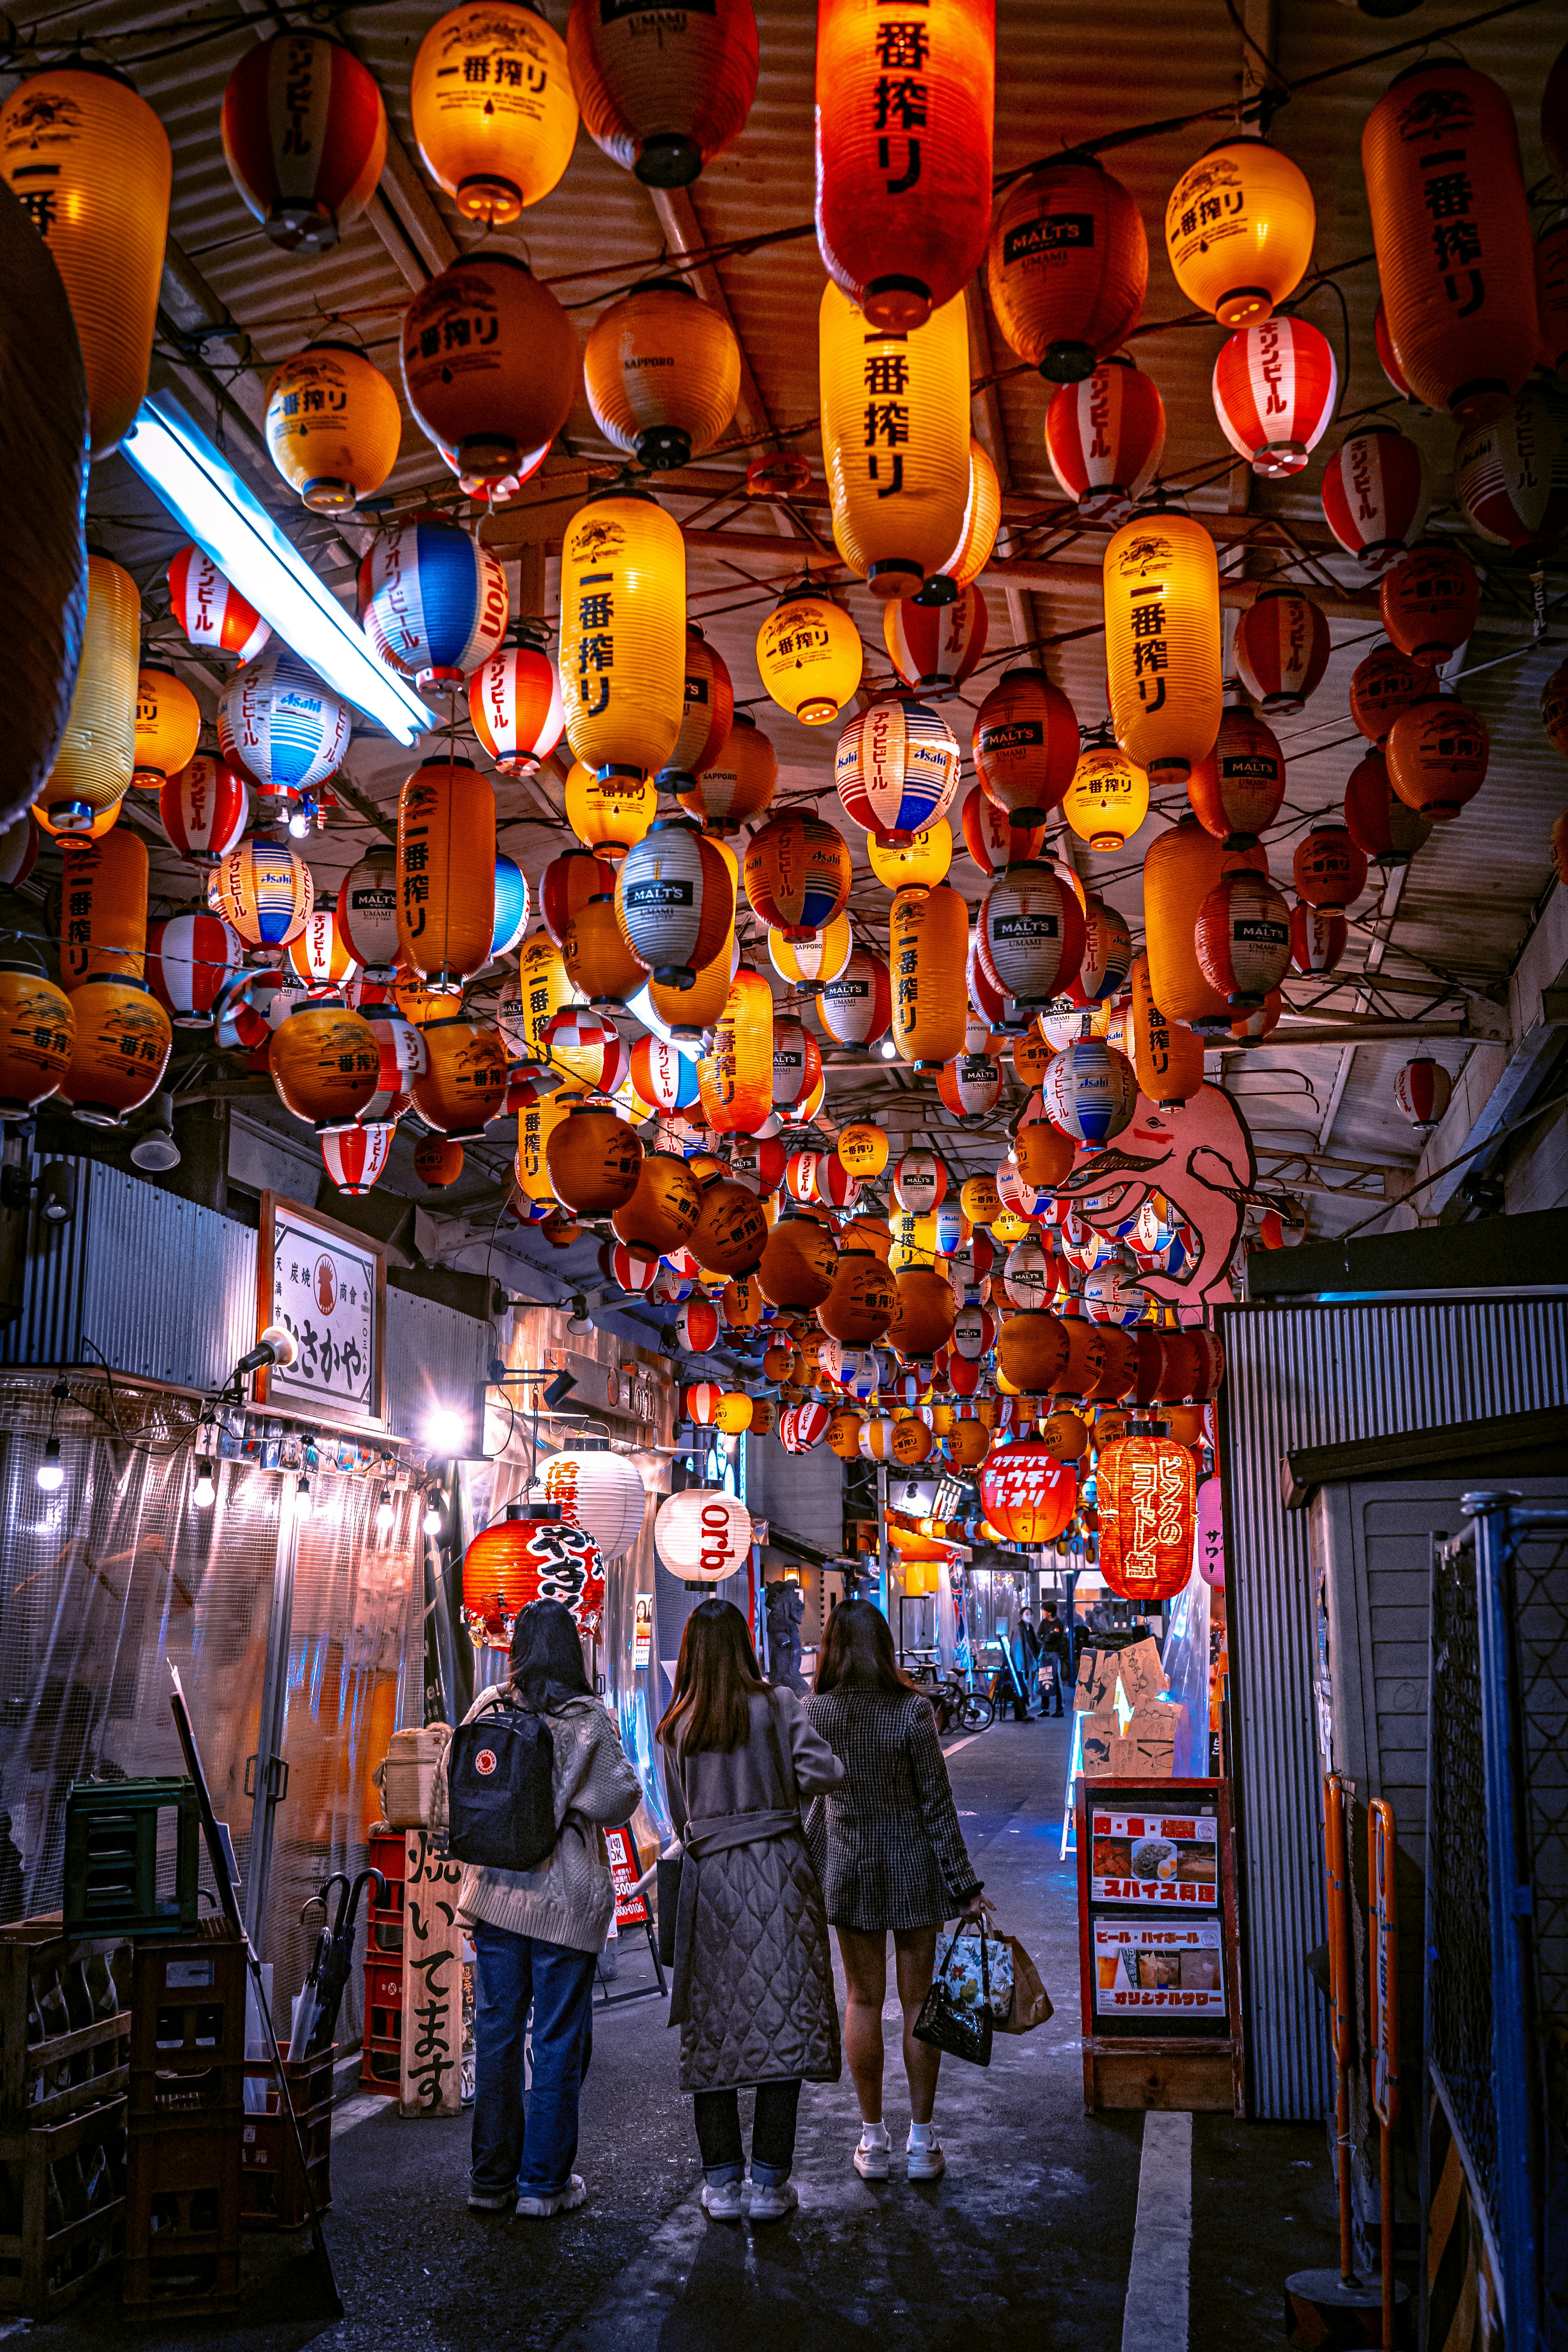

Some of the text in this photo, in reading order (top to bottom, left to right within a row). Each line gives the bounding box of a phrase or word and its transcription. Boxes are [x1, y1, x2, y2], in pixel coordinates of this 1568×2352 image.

[436, 55, 548, 95] 一番搾り
[874, 0, 930, 194] 一番搾り
[1170, 190, 1244, 244] 一番搾り
[1011, 222, 1081, 252] MALT'S
[1420, 149, 1486, 318] 一番搾り
[1021, 250, 1068, 271] UMAMI
[406, 316, 498, 361] 一番搾り
[623, 356, 675, 370] SAPPORO
[1258, 321, 1287, 416] キリンビール
[270, 389, 347, 417] 一番搾り
[864, 332, 909, 499] 一番搾り
[1351, 439, 1378, 521] キリンビール
[579, 573, 614, 717] 一番搾り
[765, 630, 830, 660] 一番搾り
[1130, 584, 1168, 714] 一番搾り
[1286, 599, 1304, 673] キリンビール
[490, 654, 508, 729] キリンビール
[1357, 679, 1412, 697] 一番搾り
[242, 664, 263, 747] アサヒビール
[280, 693, 322, 714] Asahi
[871, 711, 890, 791] アサヒビール
[989, 728, 1034, 746] MALT'S
[1420, 738, 1483, 757] 一番搾り
[914, 748, 947, 767] Asahi
[996, 748, 1027, 759] UMAMI
[1232, 762, 1273, 773] MALT'S
[190, 762, 206, 831] キリンビール
[1075, 777, 1132, 794] 一番搾り
[777, 827, 795, 898] アサヒビール
[812, 850, 841, 866] Asahi
[1301, 859, 1350, 873] 一番搾り
[229, 851, 247, 918] アサヒビール
[261, 873, 292, 885] Asahi
[403, 826, 429, 938] 一番搾り
[633, 886, 684, 901] MALT'S
[68, 878, 93, 975] 一番搾り
[314, 915, 326, 967] キリンビール
[1001, 921, 1049, 934] MALT'S
[1243, 927, 1284, 939] MALT'S
[1008, 938, 1042, 947] UMAMI
[1085, 911, 1100, 973] アサヒビール
[829, 985, 862, 995] MALT'S
[898, 936, 918, 1034] 一番搾り
[714, 1018, 737, 1106] 一番搾り
[967, 1071, 995, 1080] MALT'S
[1079, 1078, 1109, 1088] Asahi
[1398, 1069, 1412, 1113] キリンビール
[842, 1144, 874, 1156] 一番搾り
[800, 1154, 813, 1192] キリンビール
[907, 1177, 931, 1185] MALT'S
[970, 1196, 1000, 1204] 一番搾り
[717, 1214, 765, 1246] 一番搾り
[274, 1256, 283, 1321] 天満市
[289, 1261, 358, 1306] 炭焼 商會
[1015, 1273, 1040, 1281] MALT'S
[850, 1293, 895, 1309] 一番搾り
[801, 1403, 815, 1430] キリンビール
[992, 1455, 1050, 1468] ウラテンマ
[984, 1470, 1061, 1488] チョウチン
[995, 1489, 1046, 1508] ドオリ
[1157, 1455, 1183, 1545] ピンクの
[1205, 1530, 1220, 1573] サワー
[533, 1526, 586, 1608] やき
[611, 1851, 624, 1862] OK
[1105, 1880, 1216, 1902] スパイス料理
[1096, 1931, 1200, 1945] ビール・ハイボール
[405, 1830, 462, 2110] 焼いてます
[1114, 1992, 1222, 2007] オリジナルサワー
